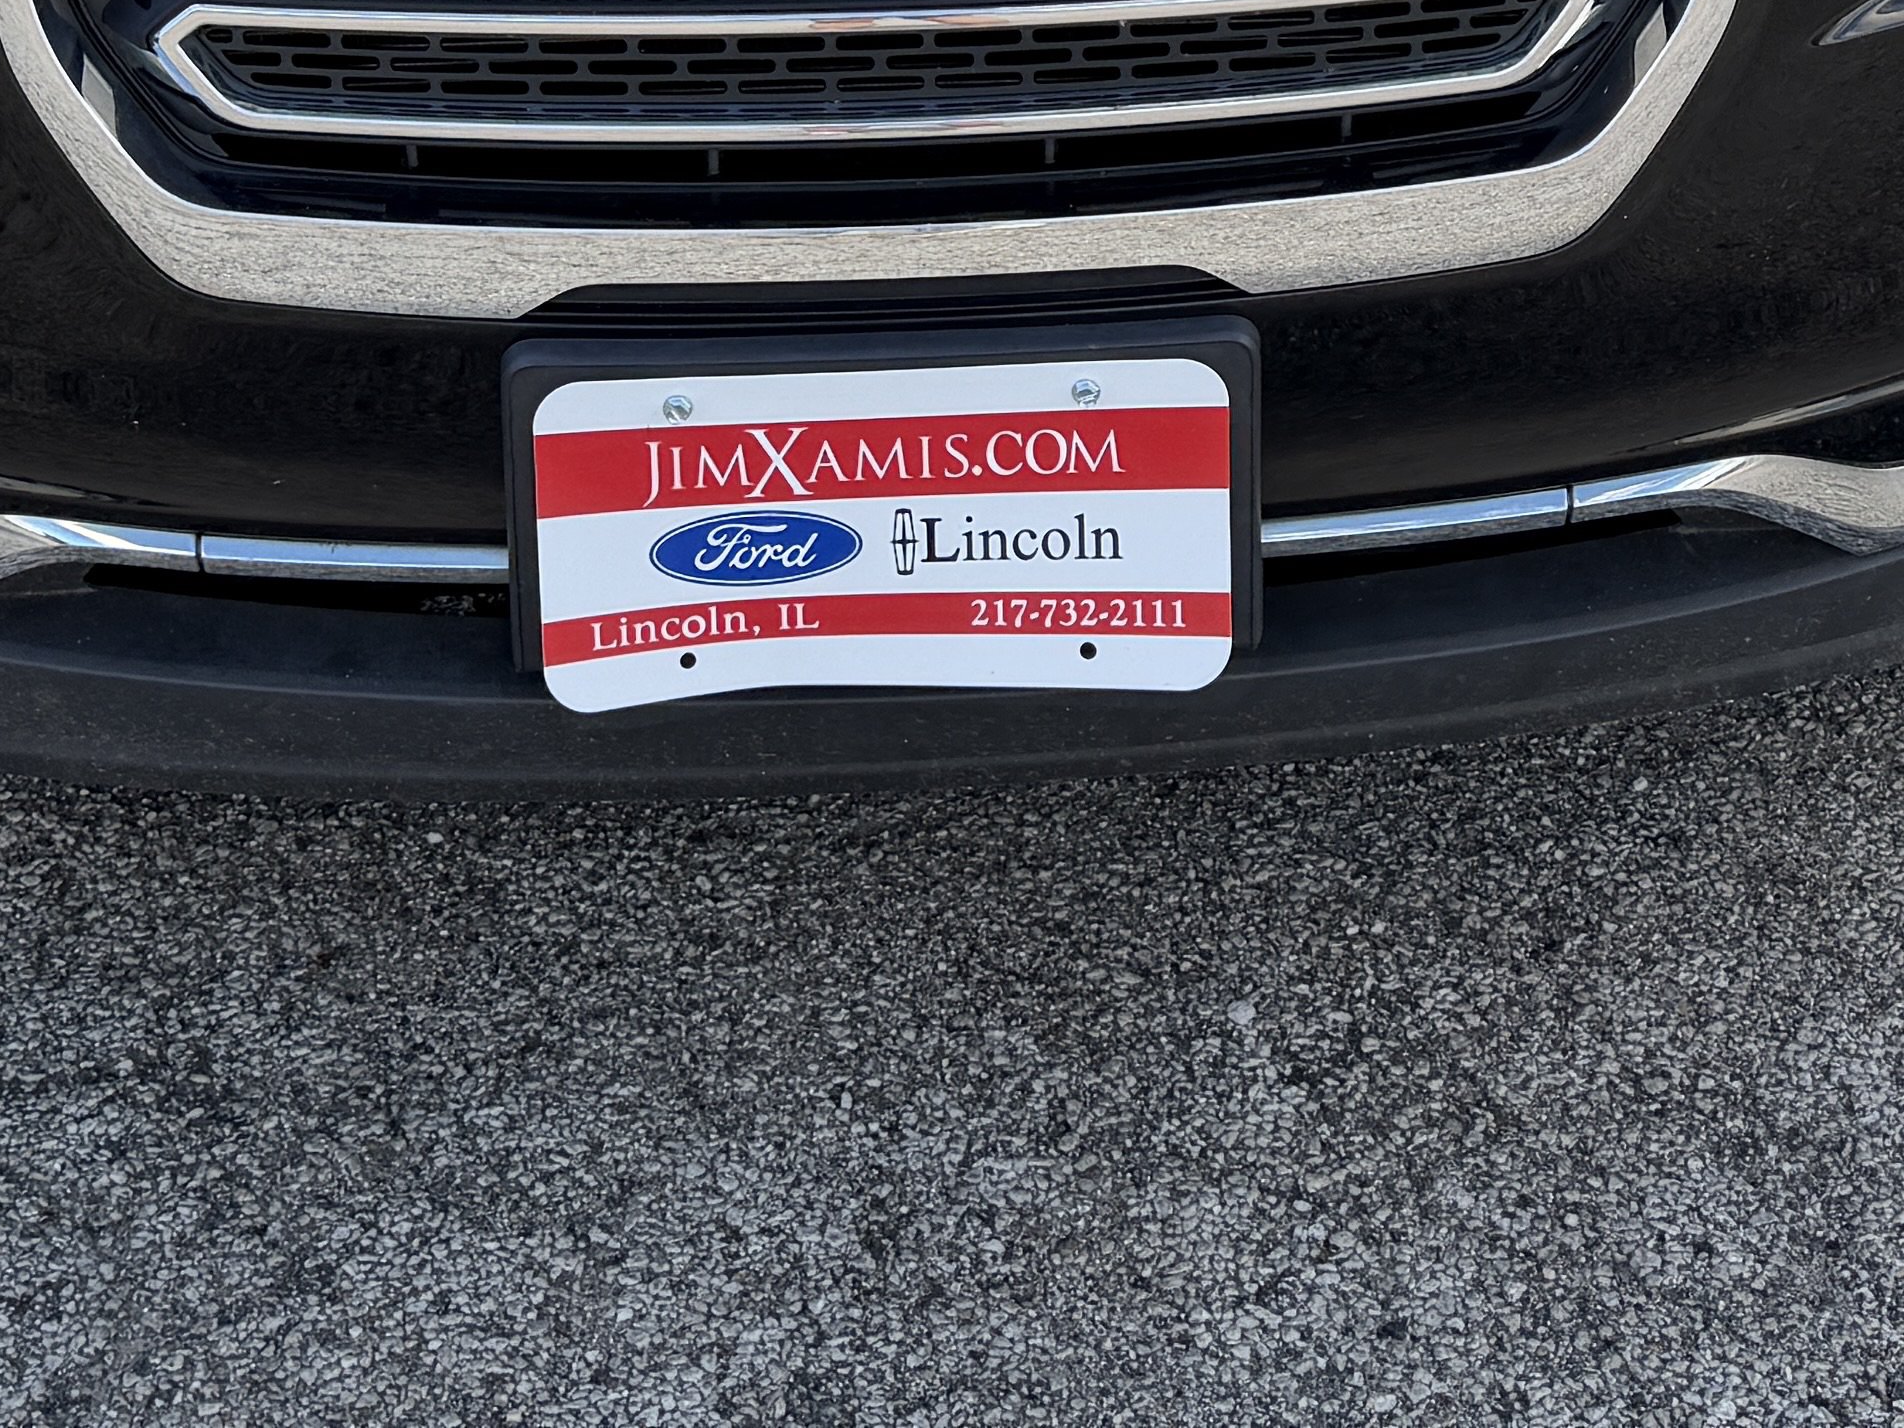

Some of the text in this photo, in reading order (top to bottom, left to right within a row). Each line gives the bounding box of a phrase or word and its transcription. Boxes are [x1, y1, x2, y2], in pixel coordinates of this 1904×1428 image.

[695, 523, 817, 572] Ford
[920, 513, 1124, 563] Lincoln
[590, 602, 820, 651] Lincoln, IL
[970, 598, 1187, 629] 217-732-2111
